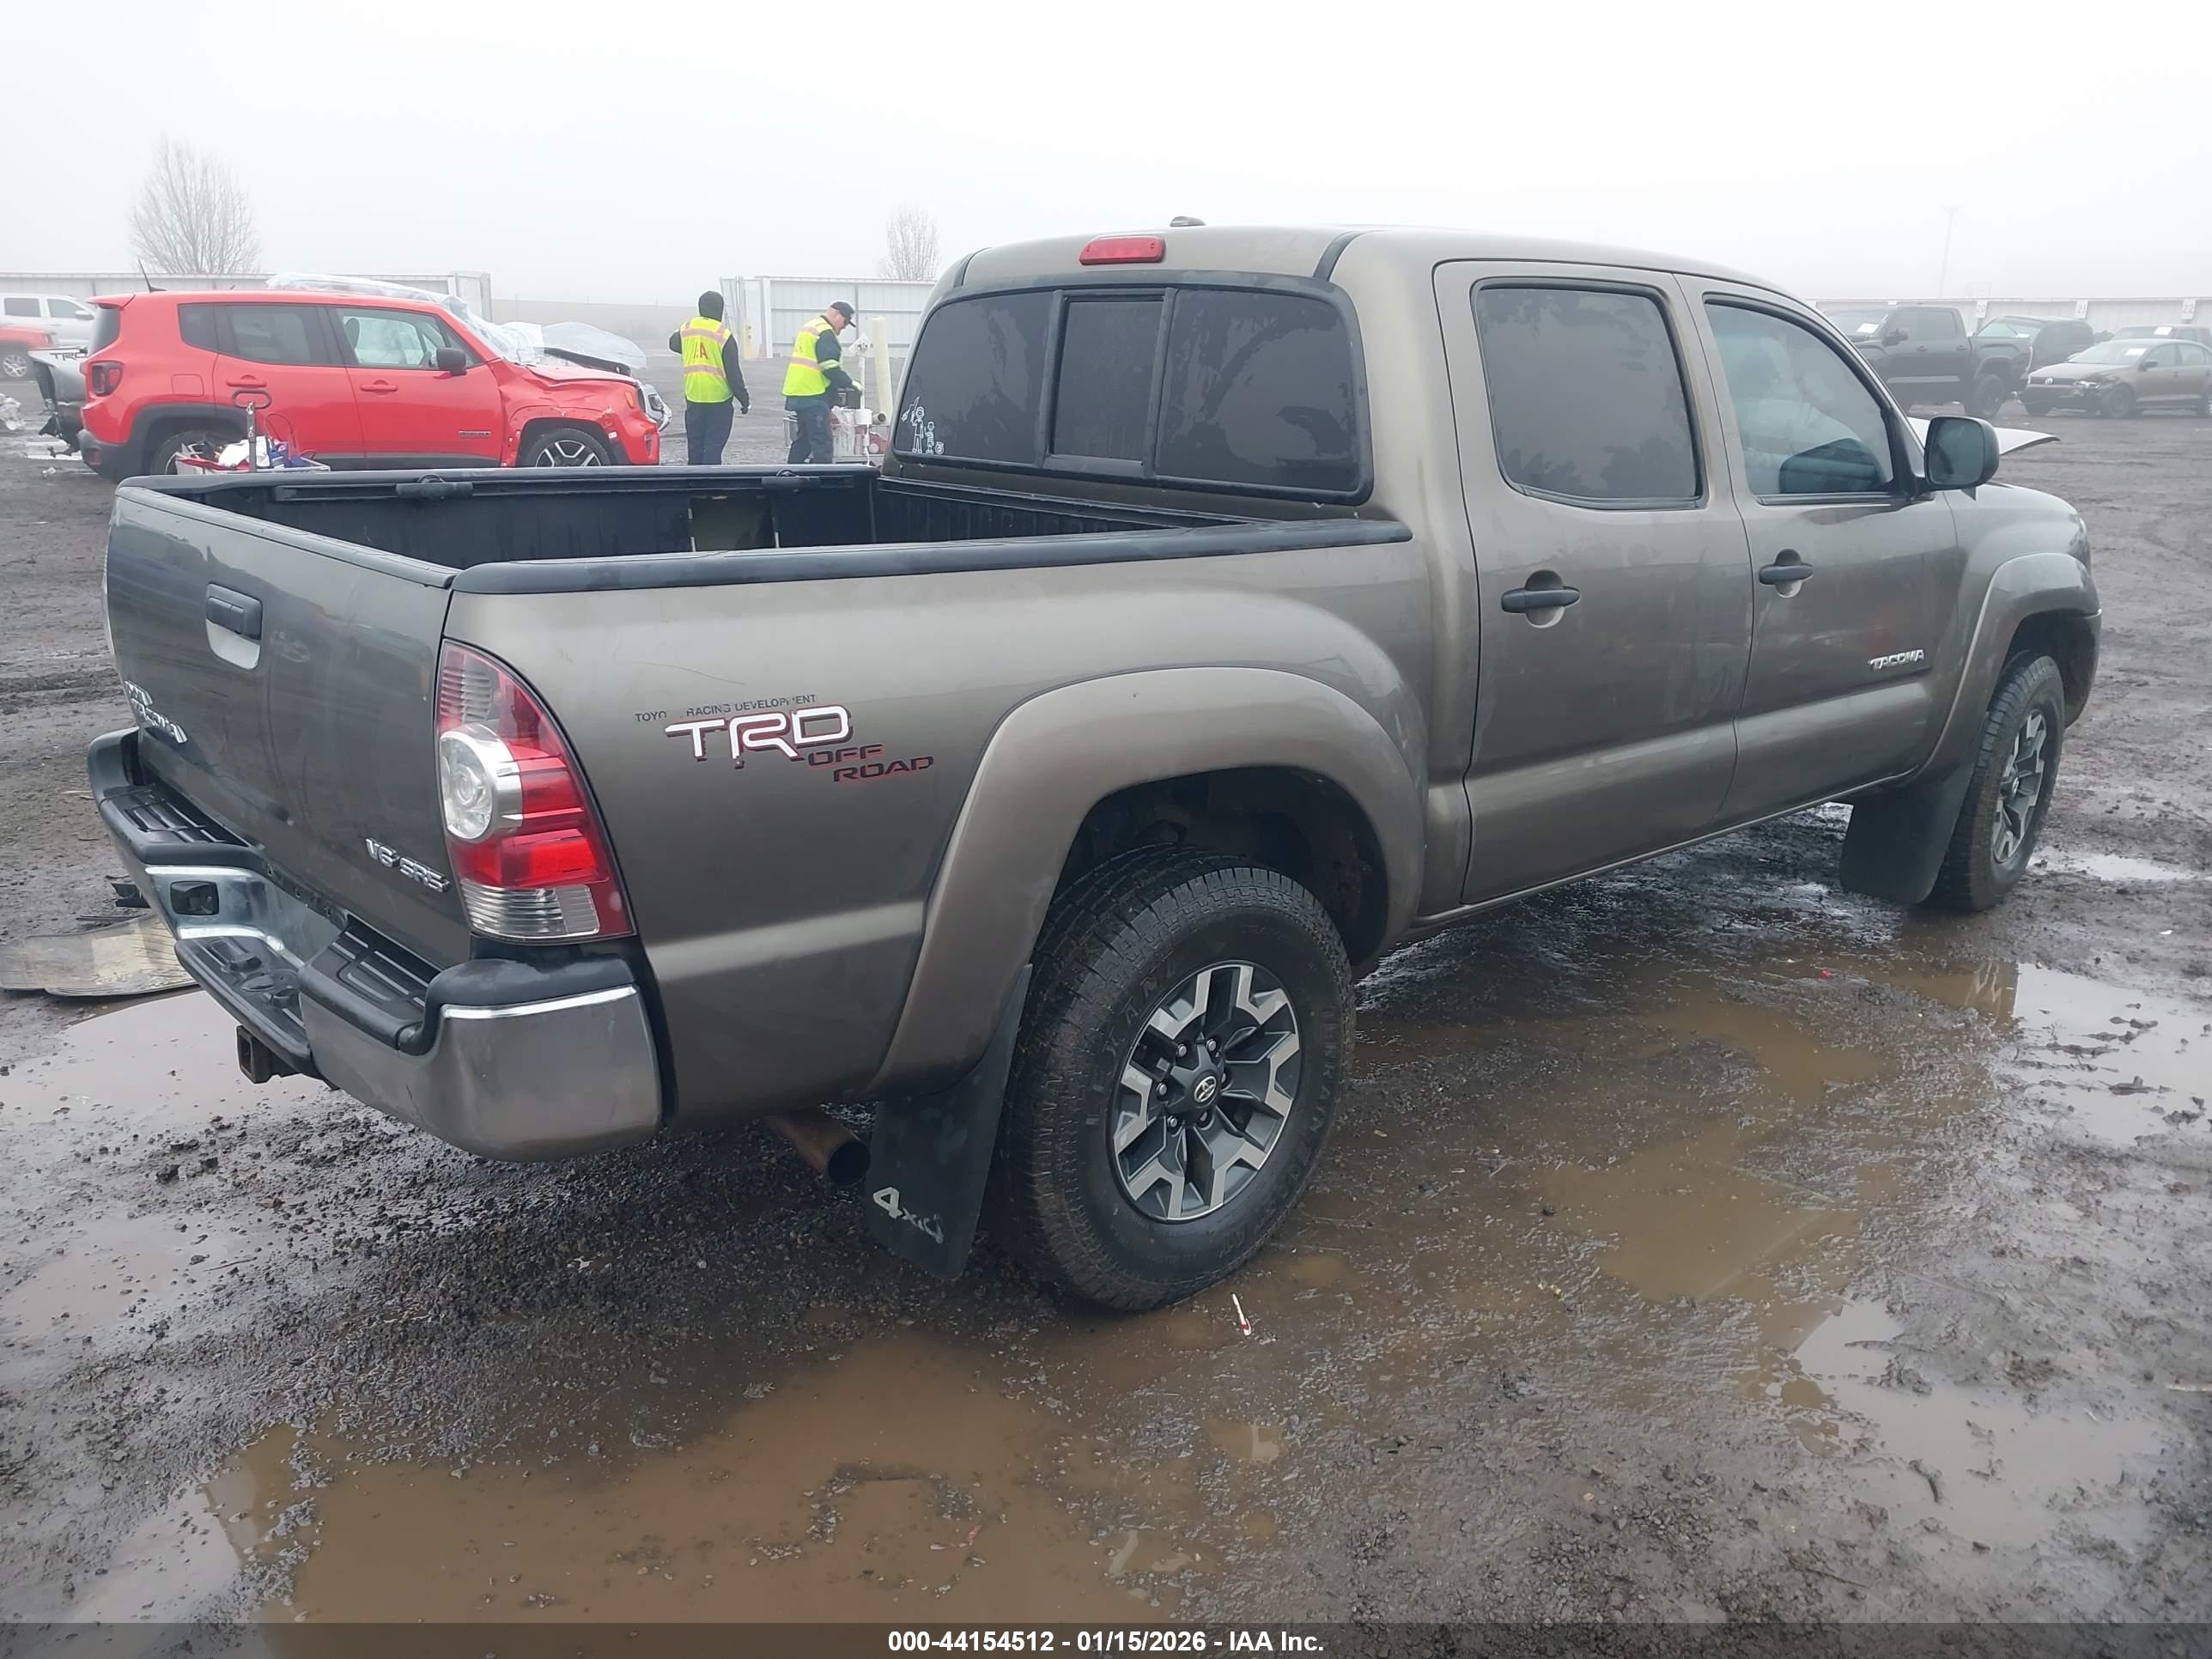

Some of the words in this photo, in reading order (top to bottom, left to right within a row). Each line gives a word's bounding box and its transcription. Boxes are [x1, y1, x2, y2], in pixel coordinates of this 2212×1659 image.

[1867, 648, 1924, 670] TACOMA
[686, 703, 732, 717] RACING
[735, 694, 817, 712] DEVELOPENT
[665, 705, 851, 764] TRD
[808, 744, 884, 766] OFF
[833, 756, 934, 782] ROAD
[365, 838, 398, 867] V6
[399, 857, 449, 892] SR5
